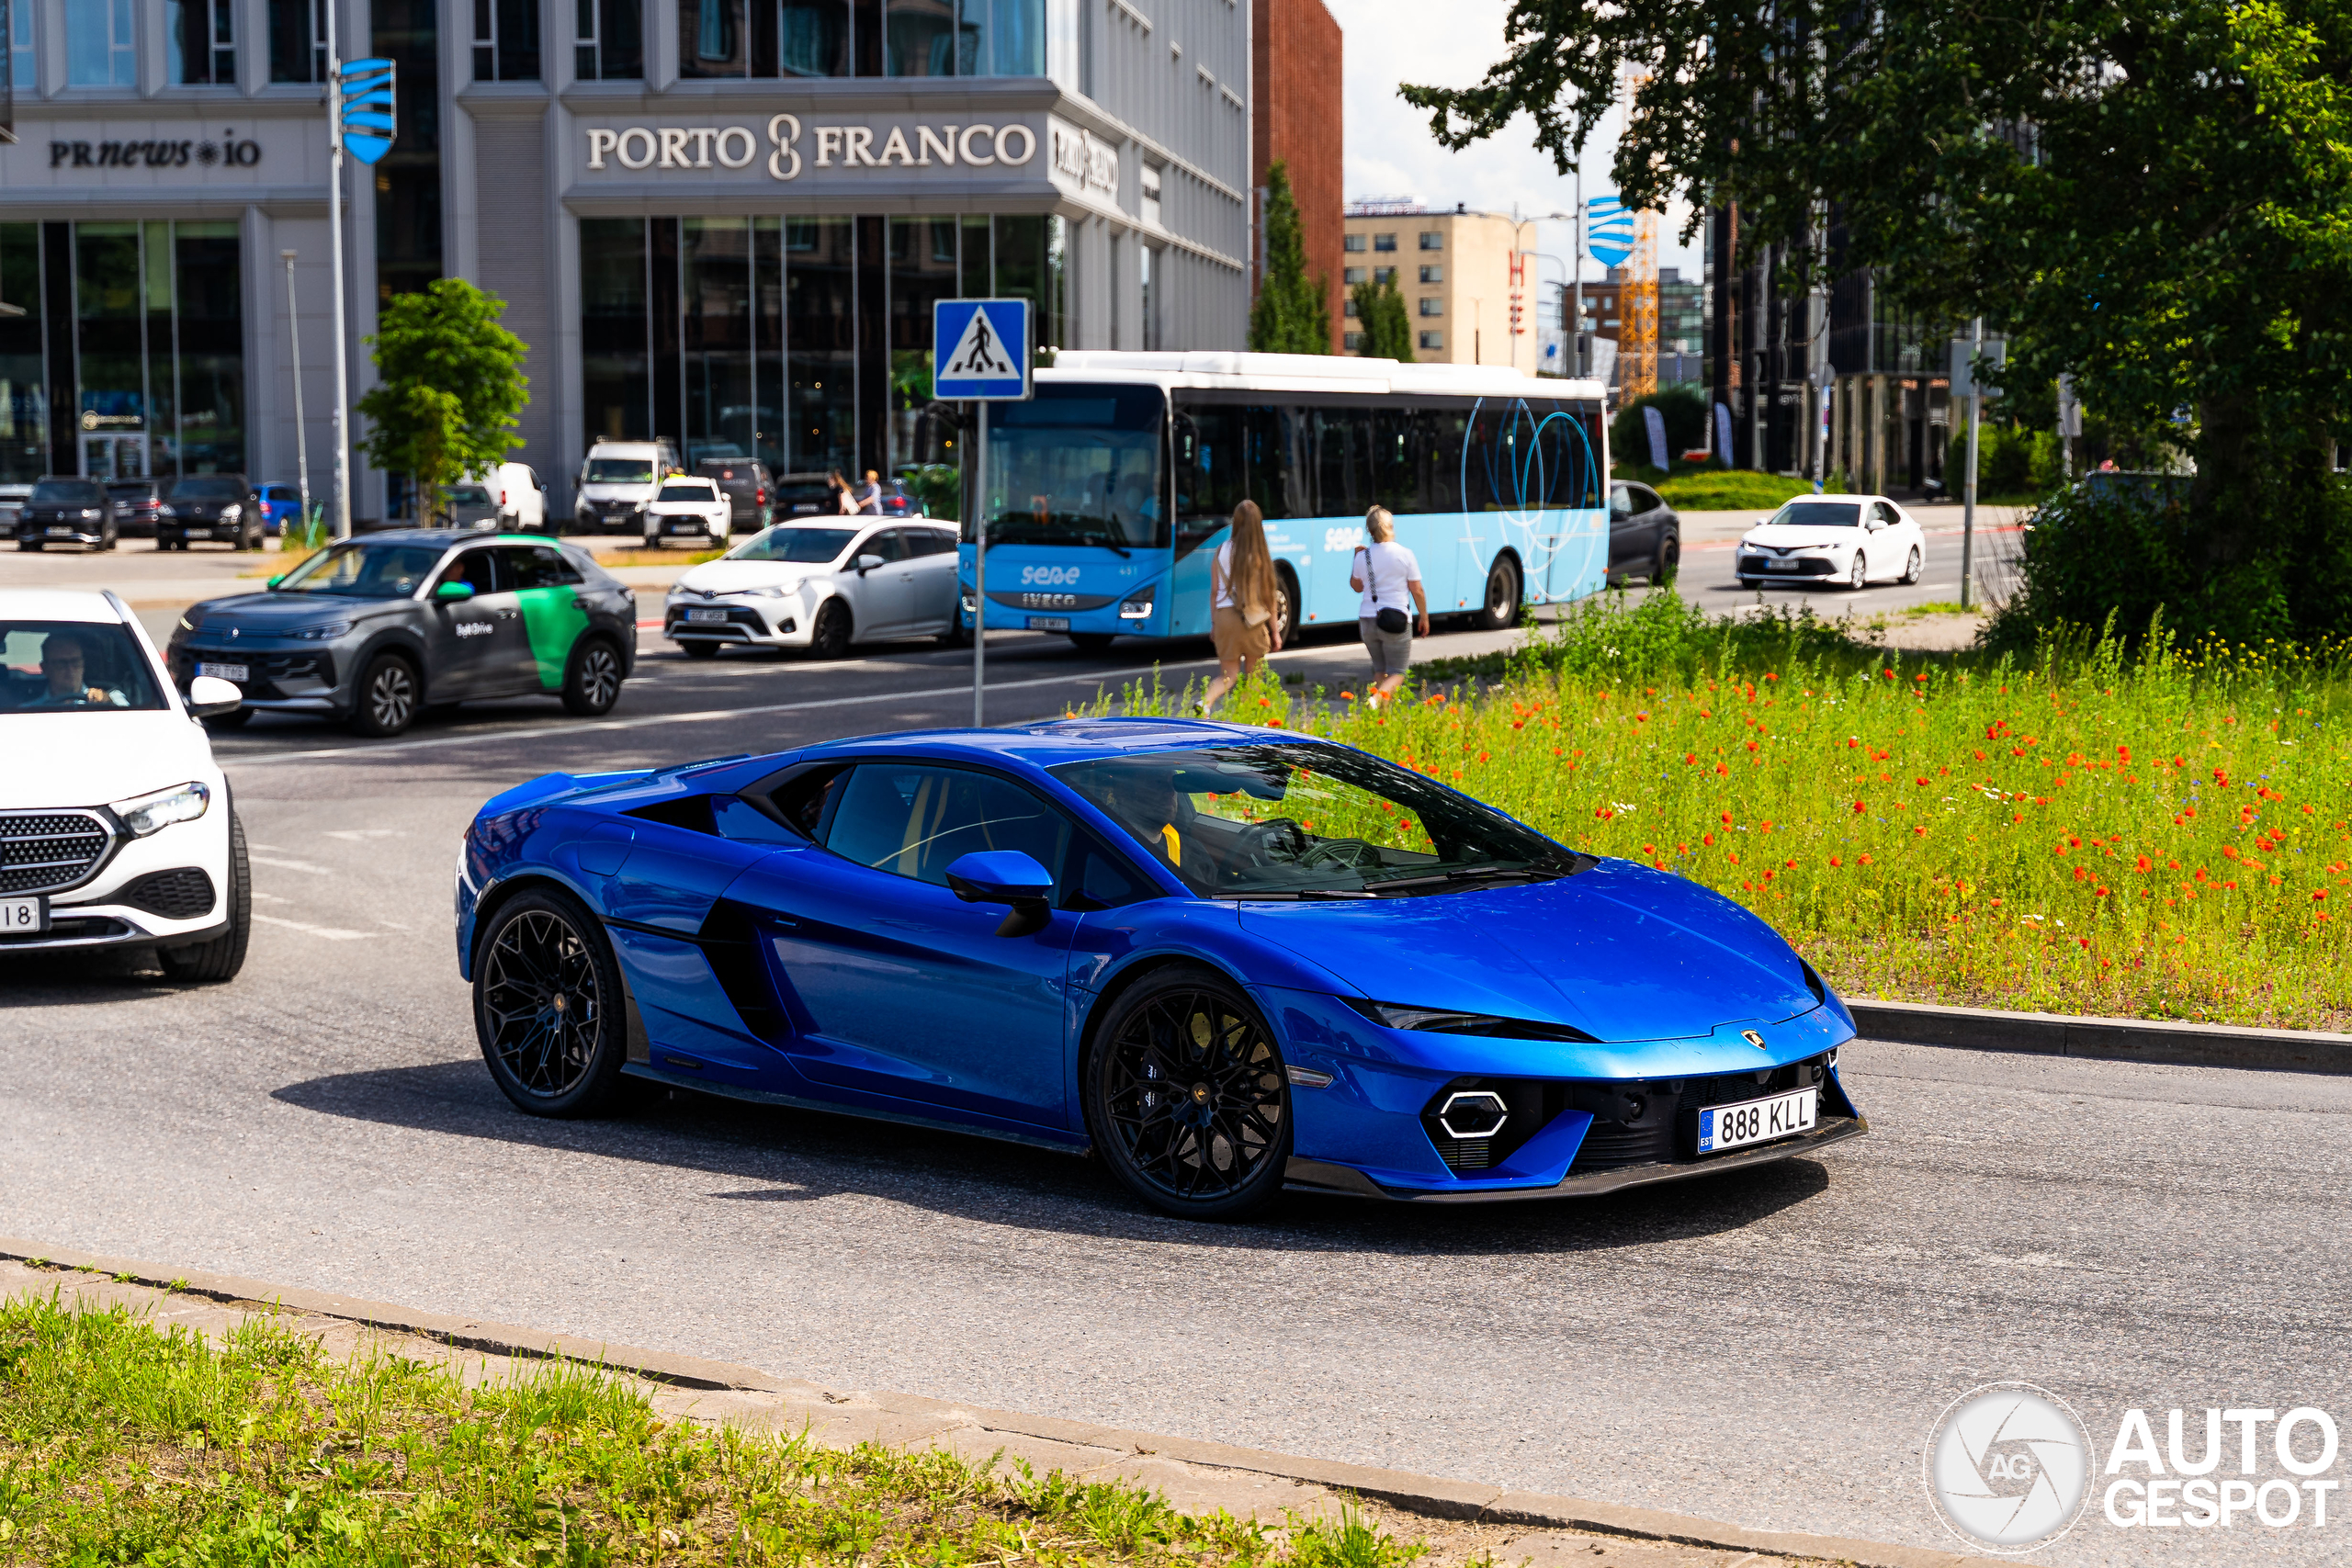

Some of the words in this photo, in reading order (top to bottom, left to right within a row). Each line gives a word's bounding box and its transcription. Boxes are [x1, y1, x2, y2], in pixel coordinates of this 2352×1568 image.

[585, 126, 758, 170] PORTO
[813, 123, 1036, 167] FRANCO
[1022, 592, 1077, 607] IVECO
[1722, 1107, 1759, 1143] 888
[1770, 1096, 1809, 1134] KLL
[1700, 1136, 1713, 1146] EST
